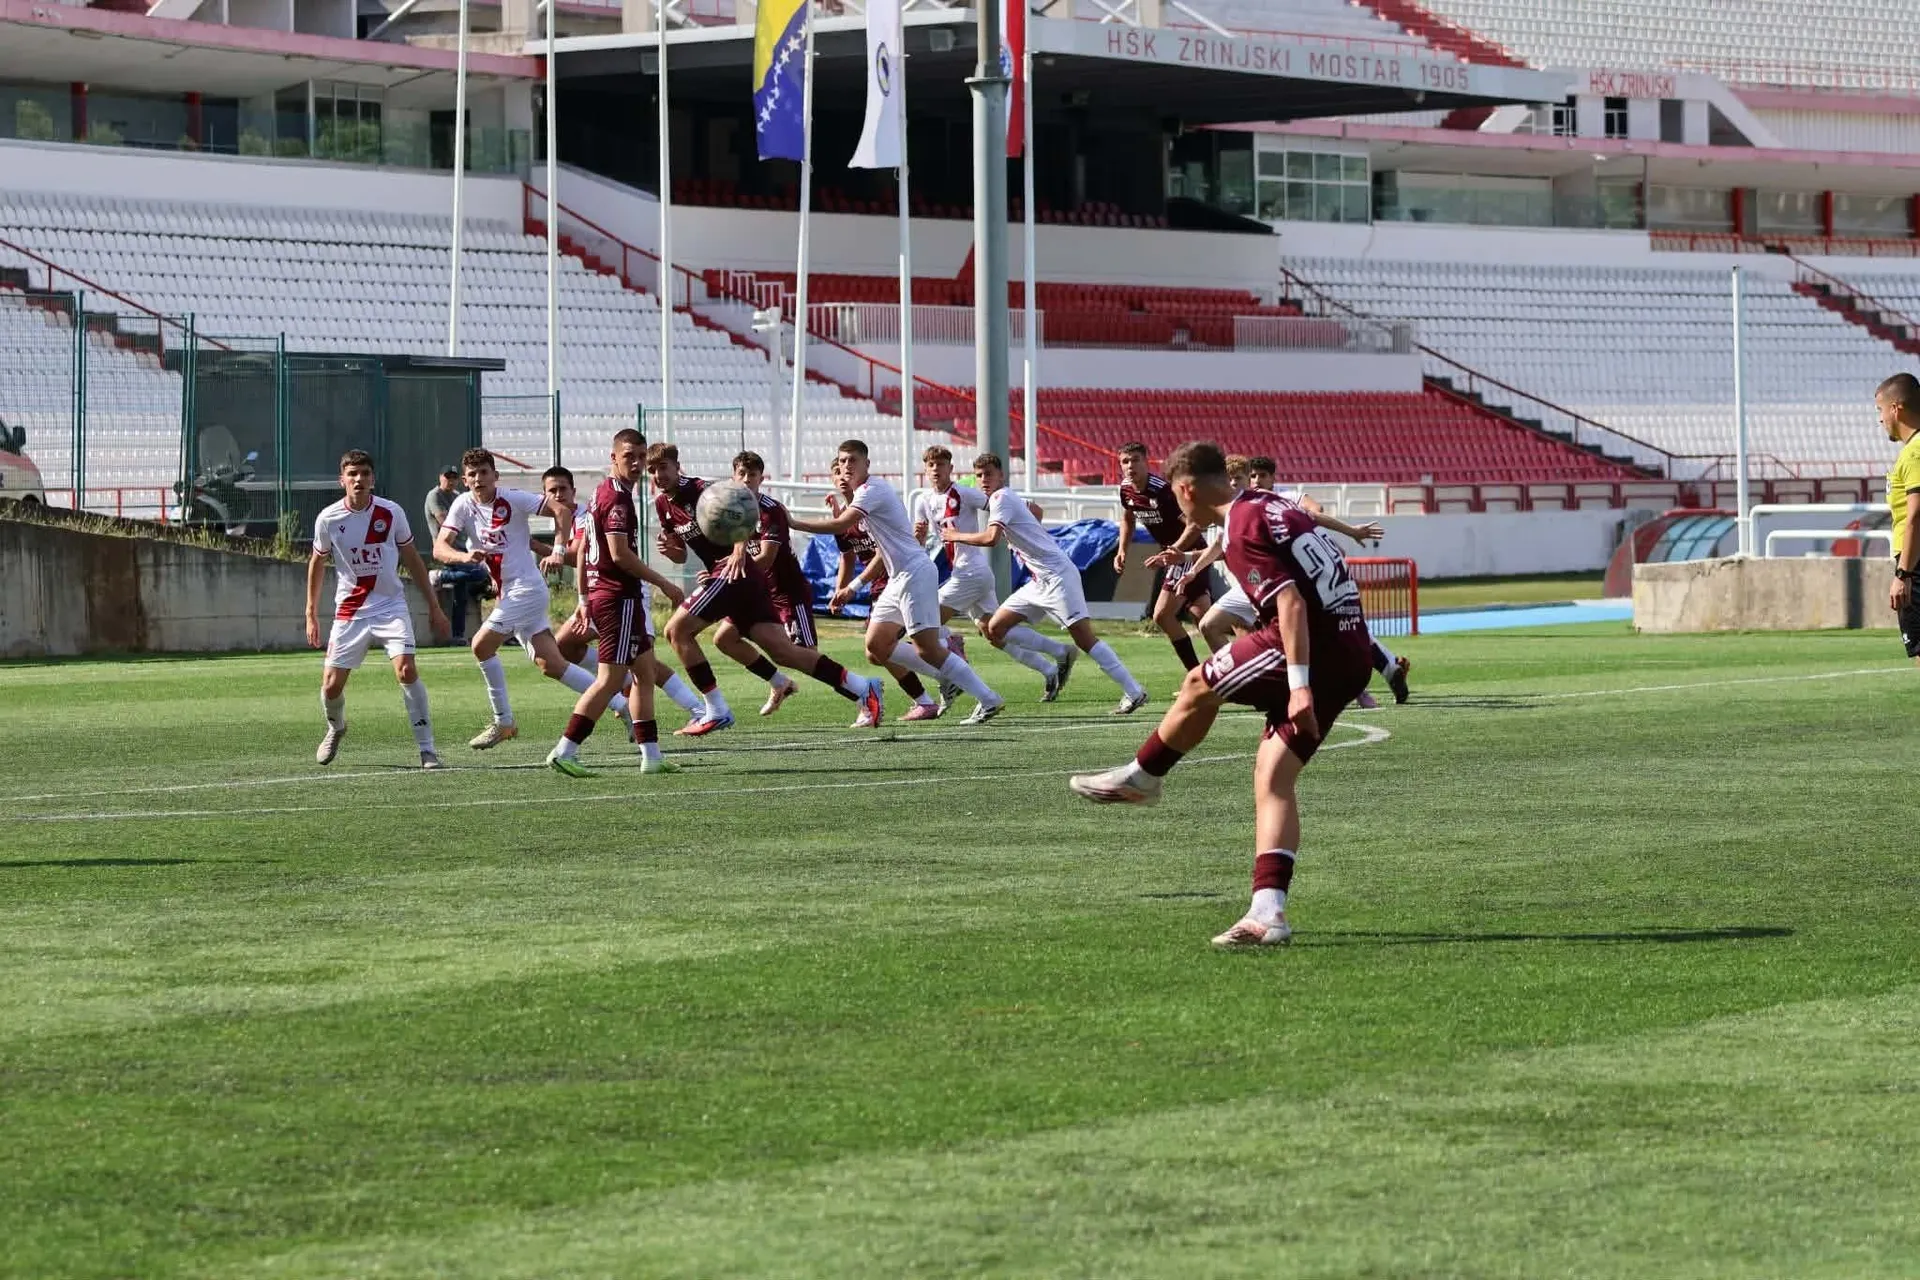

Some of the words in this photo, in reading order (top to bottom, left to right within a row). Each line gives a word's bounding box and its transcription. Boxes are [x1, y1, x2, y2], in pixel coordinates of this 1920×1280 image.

[1178, 37, 1291, 72] ZRINJSKI
[1309, 52, 1400, 83] MOSTAR
[1420, 62, 1469, 90] 1905
